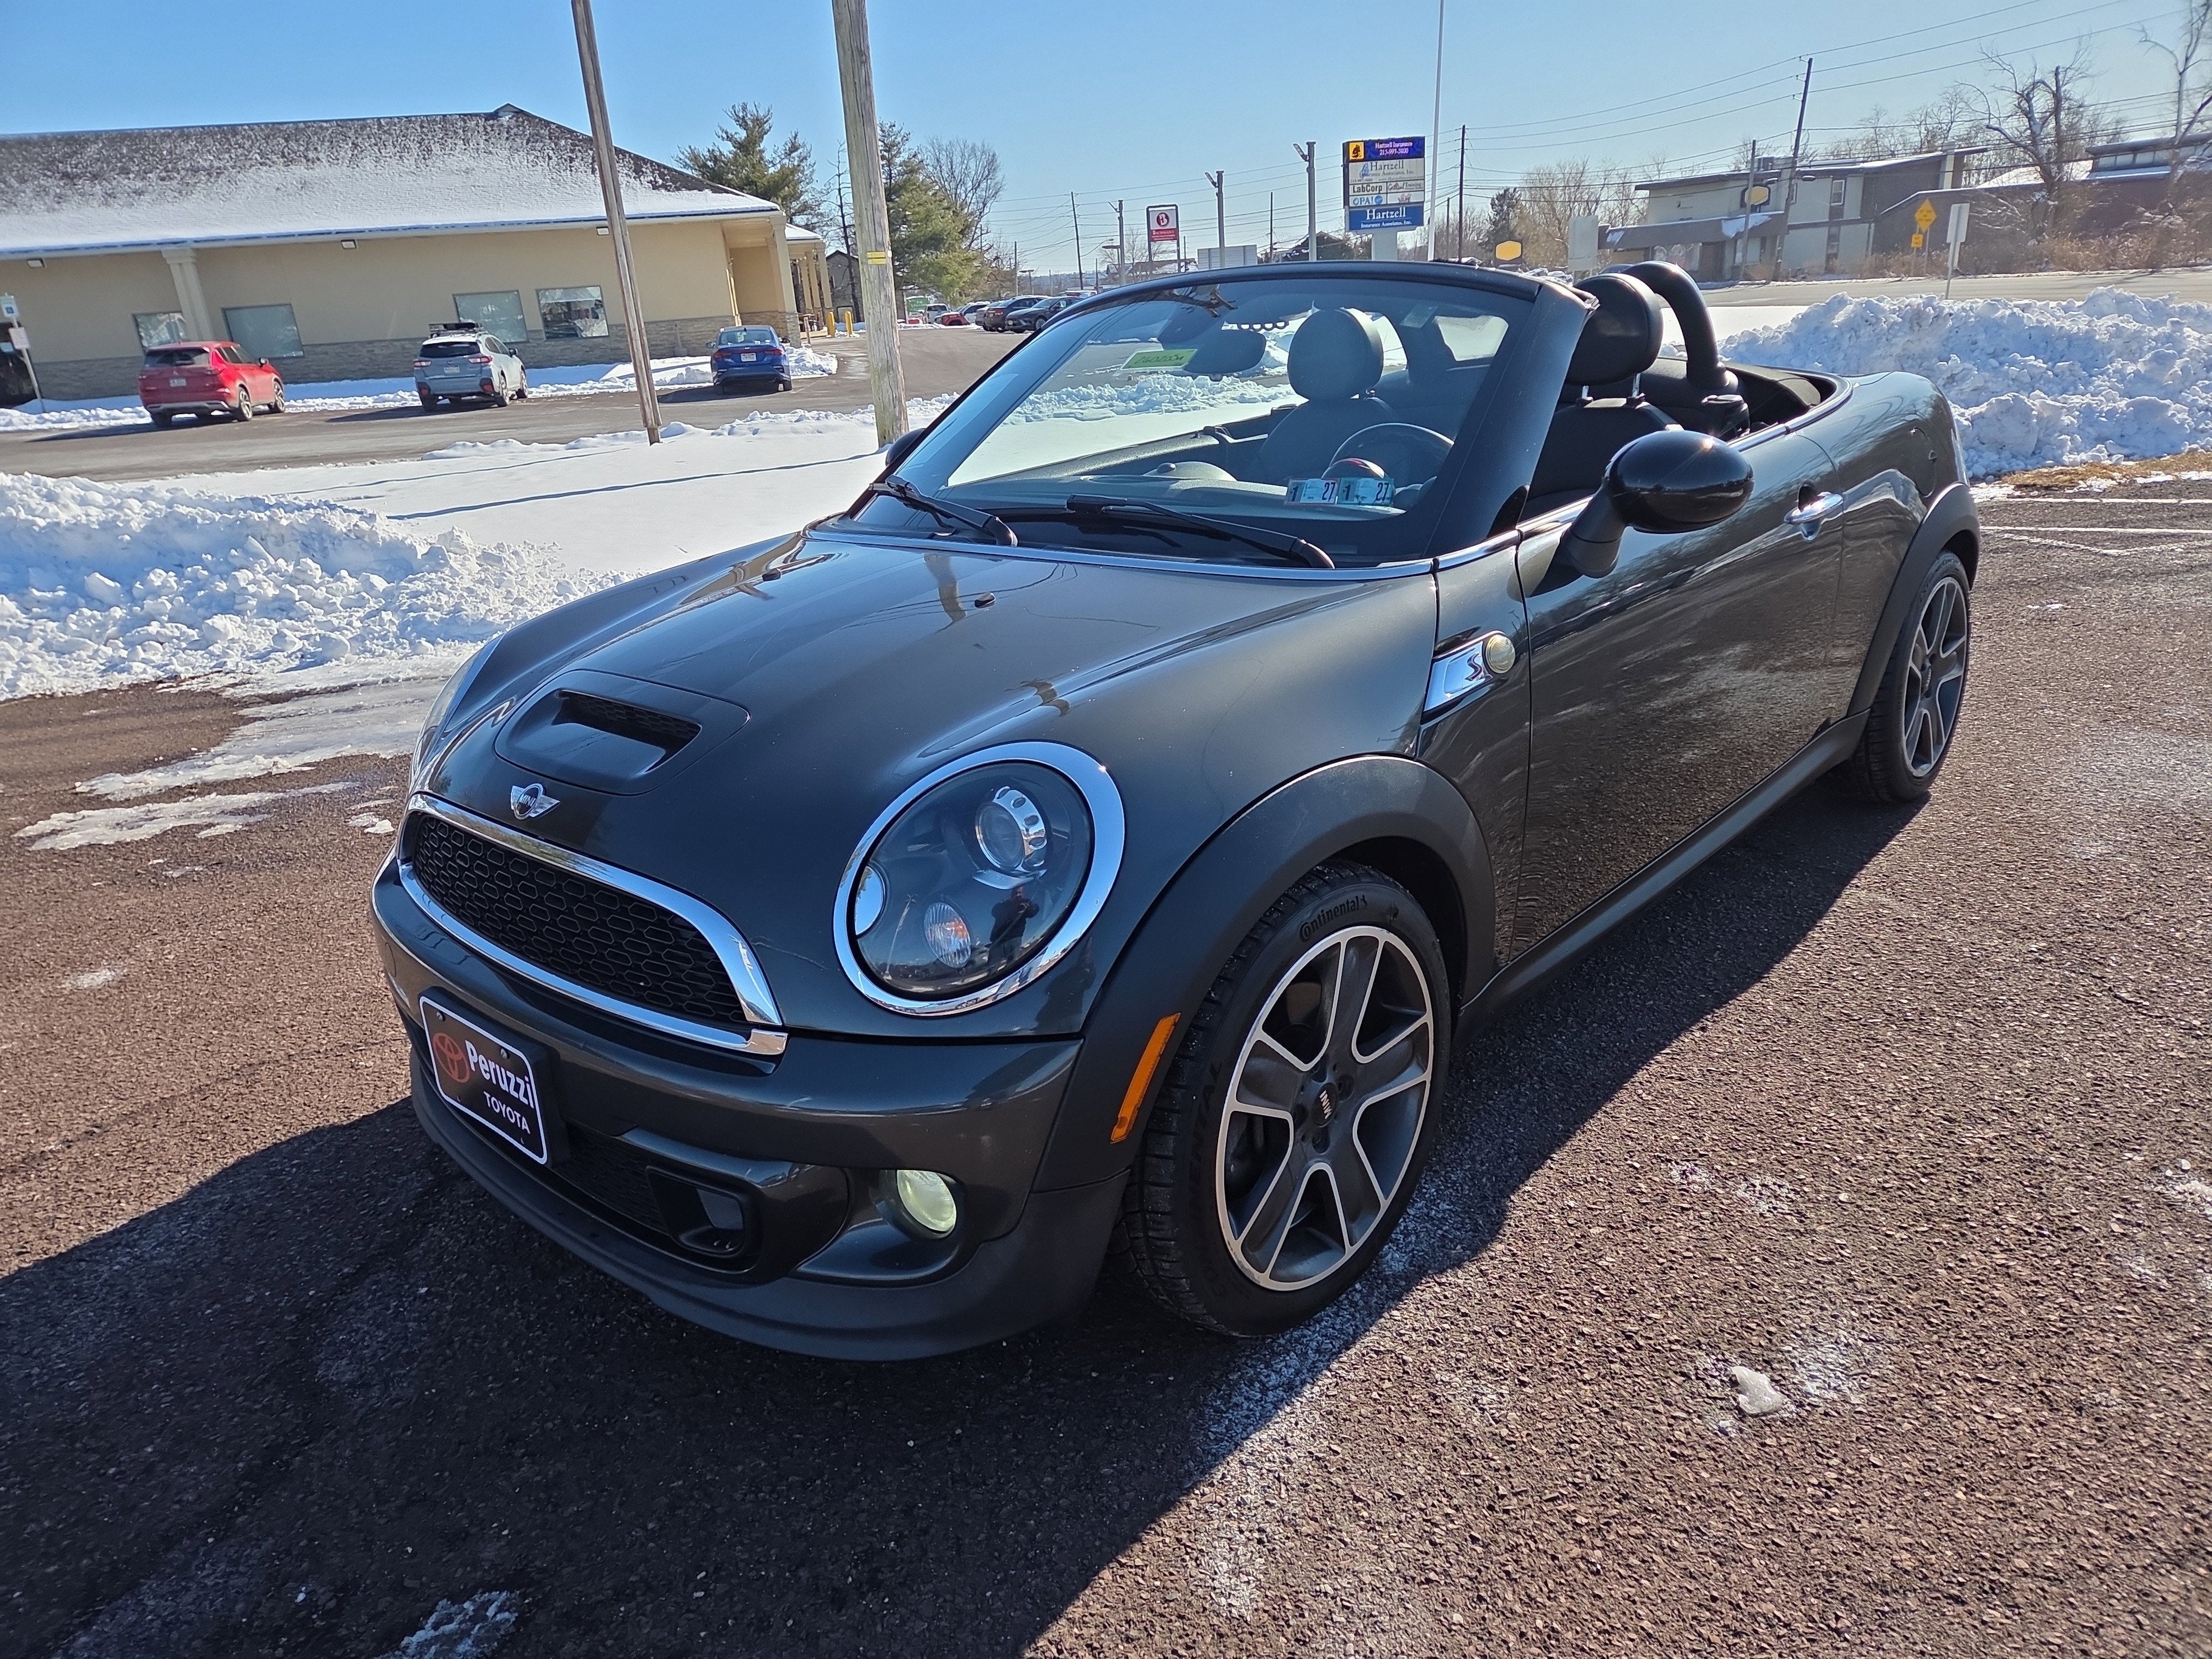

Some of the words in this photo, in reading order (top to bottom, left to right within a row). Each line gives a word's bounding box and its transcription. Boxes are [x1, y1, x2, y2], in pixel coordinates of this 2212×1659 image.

[1370, 160, 1404, 171] Hartzell
[1353, 184, 1382, 194] LabCorp
[1353, 196, 1373, 205] OPA!
[1366, 207, 1406, 220] Hartzell
[1322, 482, 1336, 501] 27
[1375, 482, 1390, 501] 27
[519, 795, 536, 806] MINI
[1299, 895, 1361, 943] Continental
[465, 1039, 535, 1109] Peruzzi
[483, 1091, 531, 1135] TOYOTA
[1319, 1089, 1333, 1120] MINI
